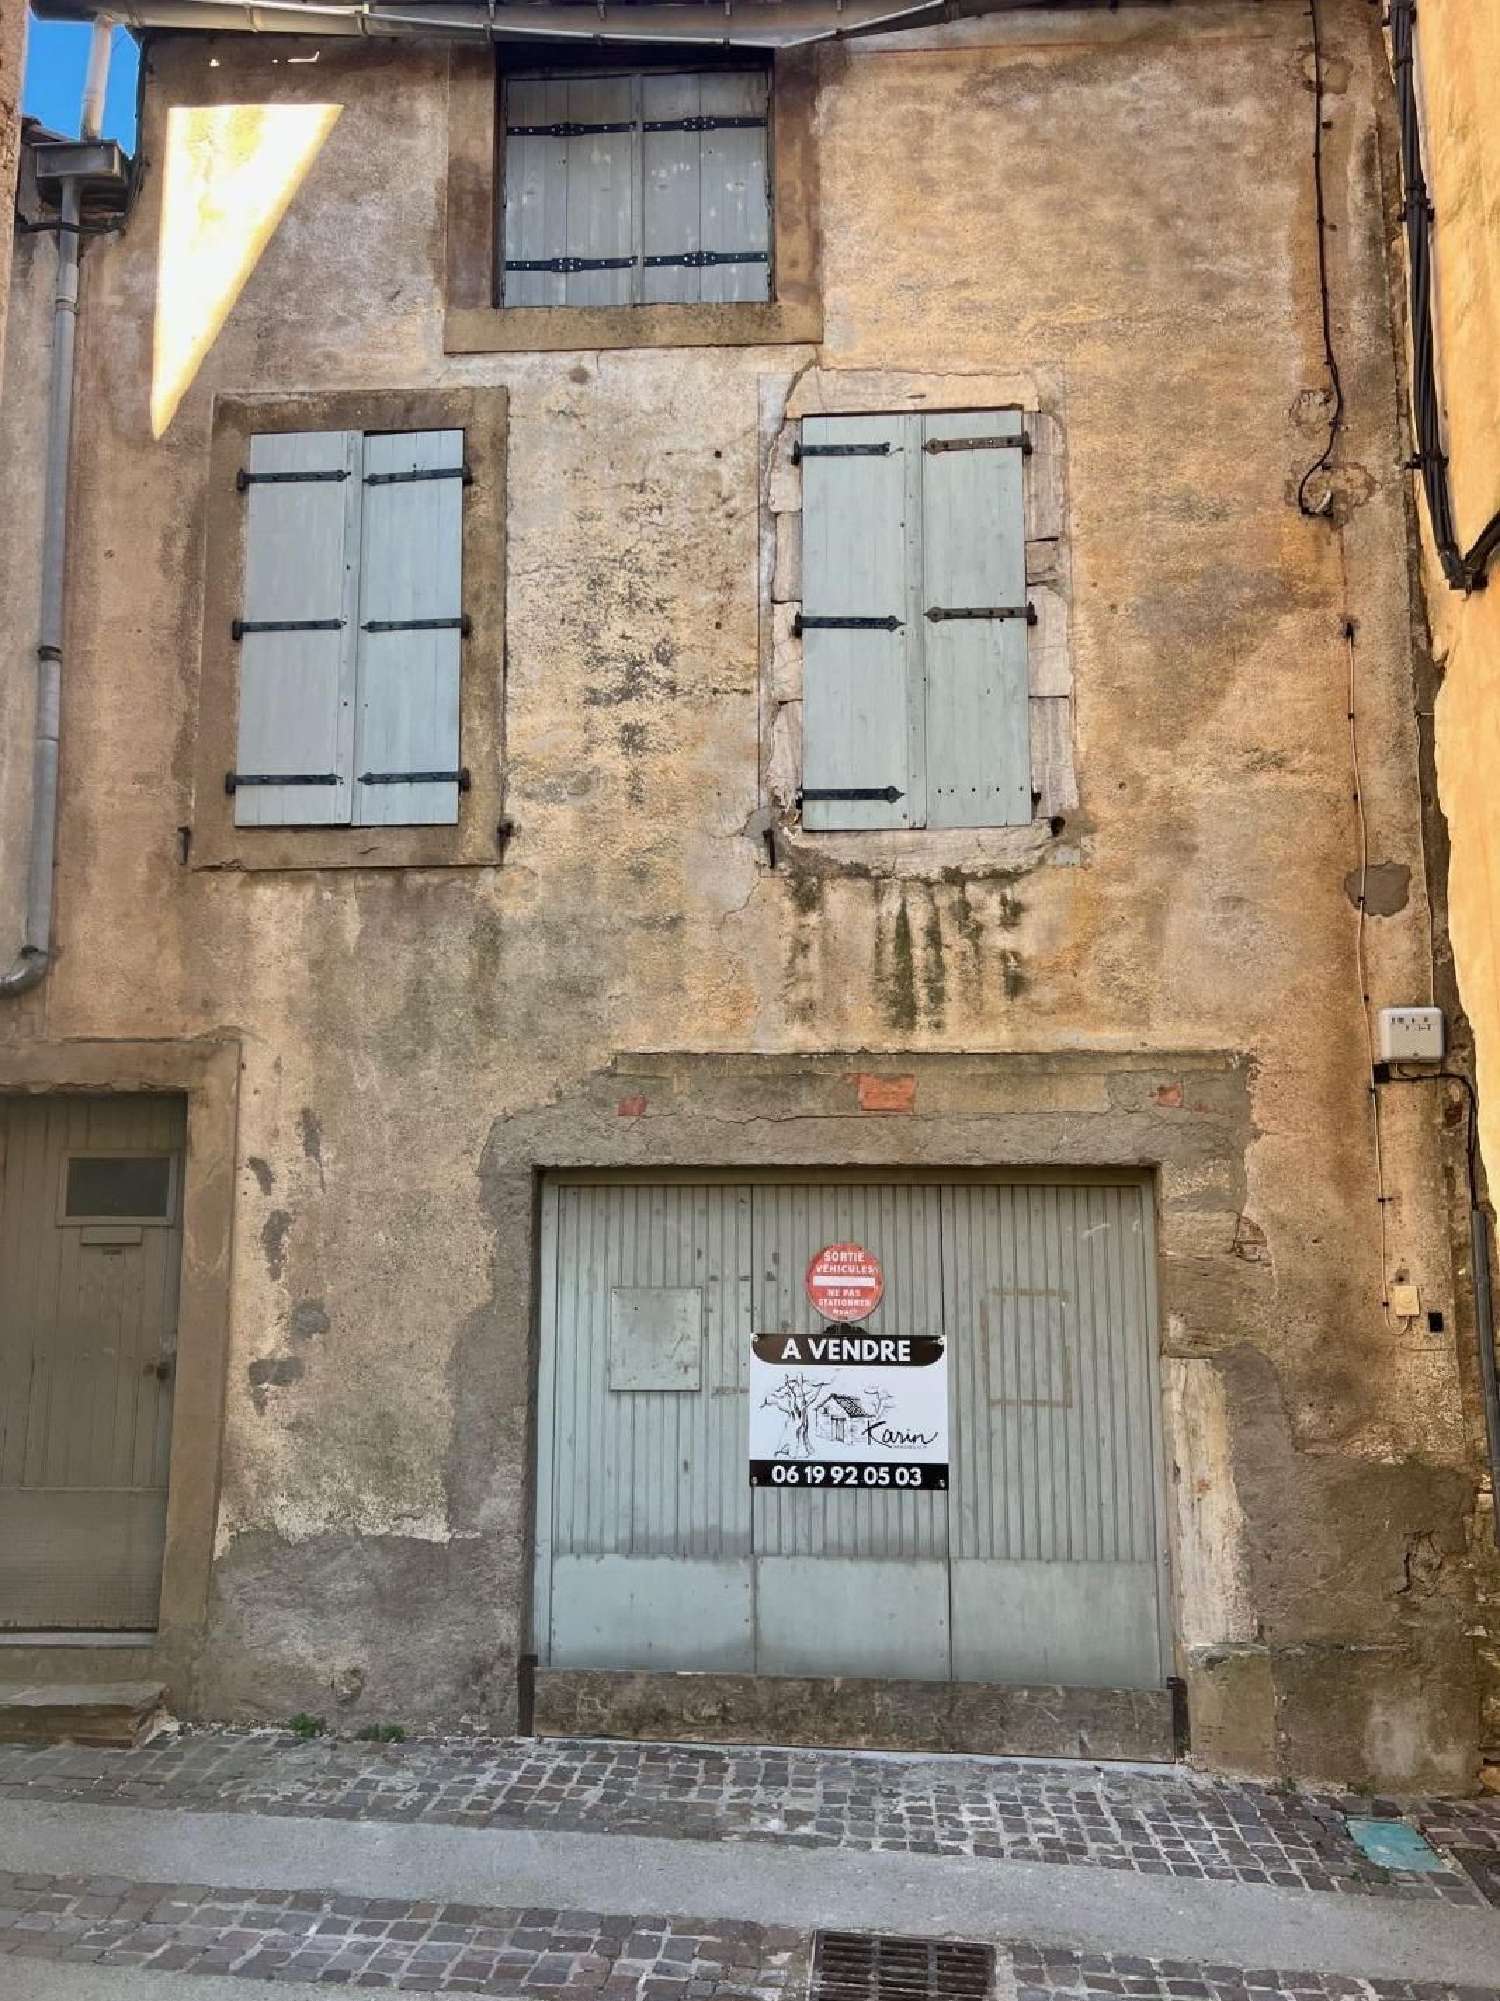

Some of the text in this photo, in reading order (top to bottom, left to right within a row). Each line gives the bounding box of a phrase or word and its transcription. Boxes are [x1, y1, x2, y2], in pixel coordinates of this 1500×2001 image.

[823, 1251, 865, 1262] SORTIE
[844, 1289, 861, 1297] PAS
[781, 1339, 911, 1362] A VENDRE
[861, 1420, 939, 1447] Karin
[771, 1465, 922, 1486] 06 19 92 05 03
